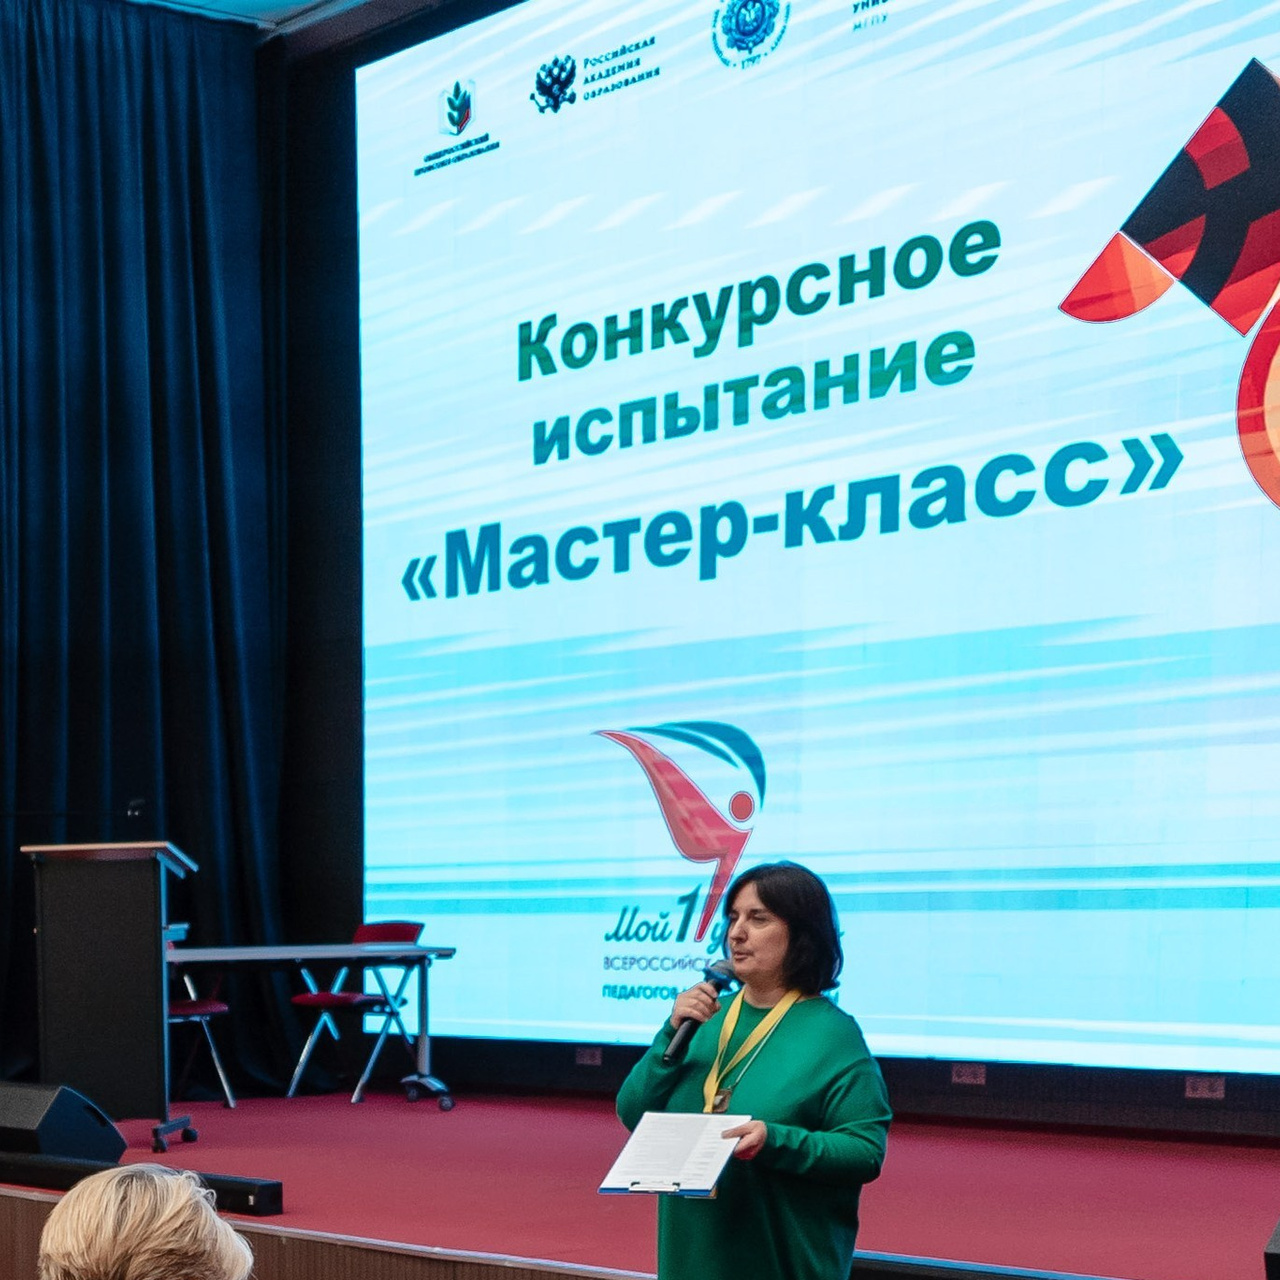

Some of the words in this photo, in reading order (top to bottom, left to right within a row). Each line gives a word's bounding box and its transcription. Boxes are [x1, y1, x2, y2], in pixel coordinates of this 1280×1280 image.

[584, 36, 655, 69] РОССИЙСКАЯ
[584, 57, 641, 86] АКАДЕМИЯ
[584, 67, 661, 101] ОБРАЗОВАНИЯ
[517, 219, 1002, 383] Конкурсное
[532, 330, 976, 466] испытание
[401, 432, 1185, 602] «Мастер-класс»
[604, 905, 671, 943] Мой
[602, 983, 678, 1001] ПЕДАГОГОВ
